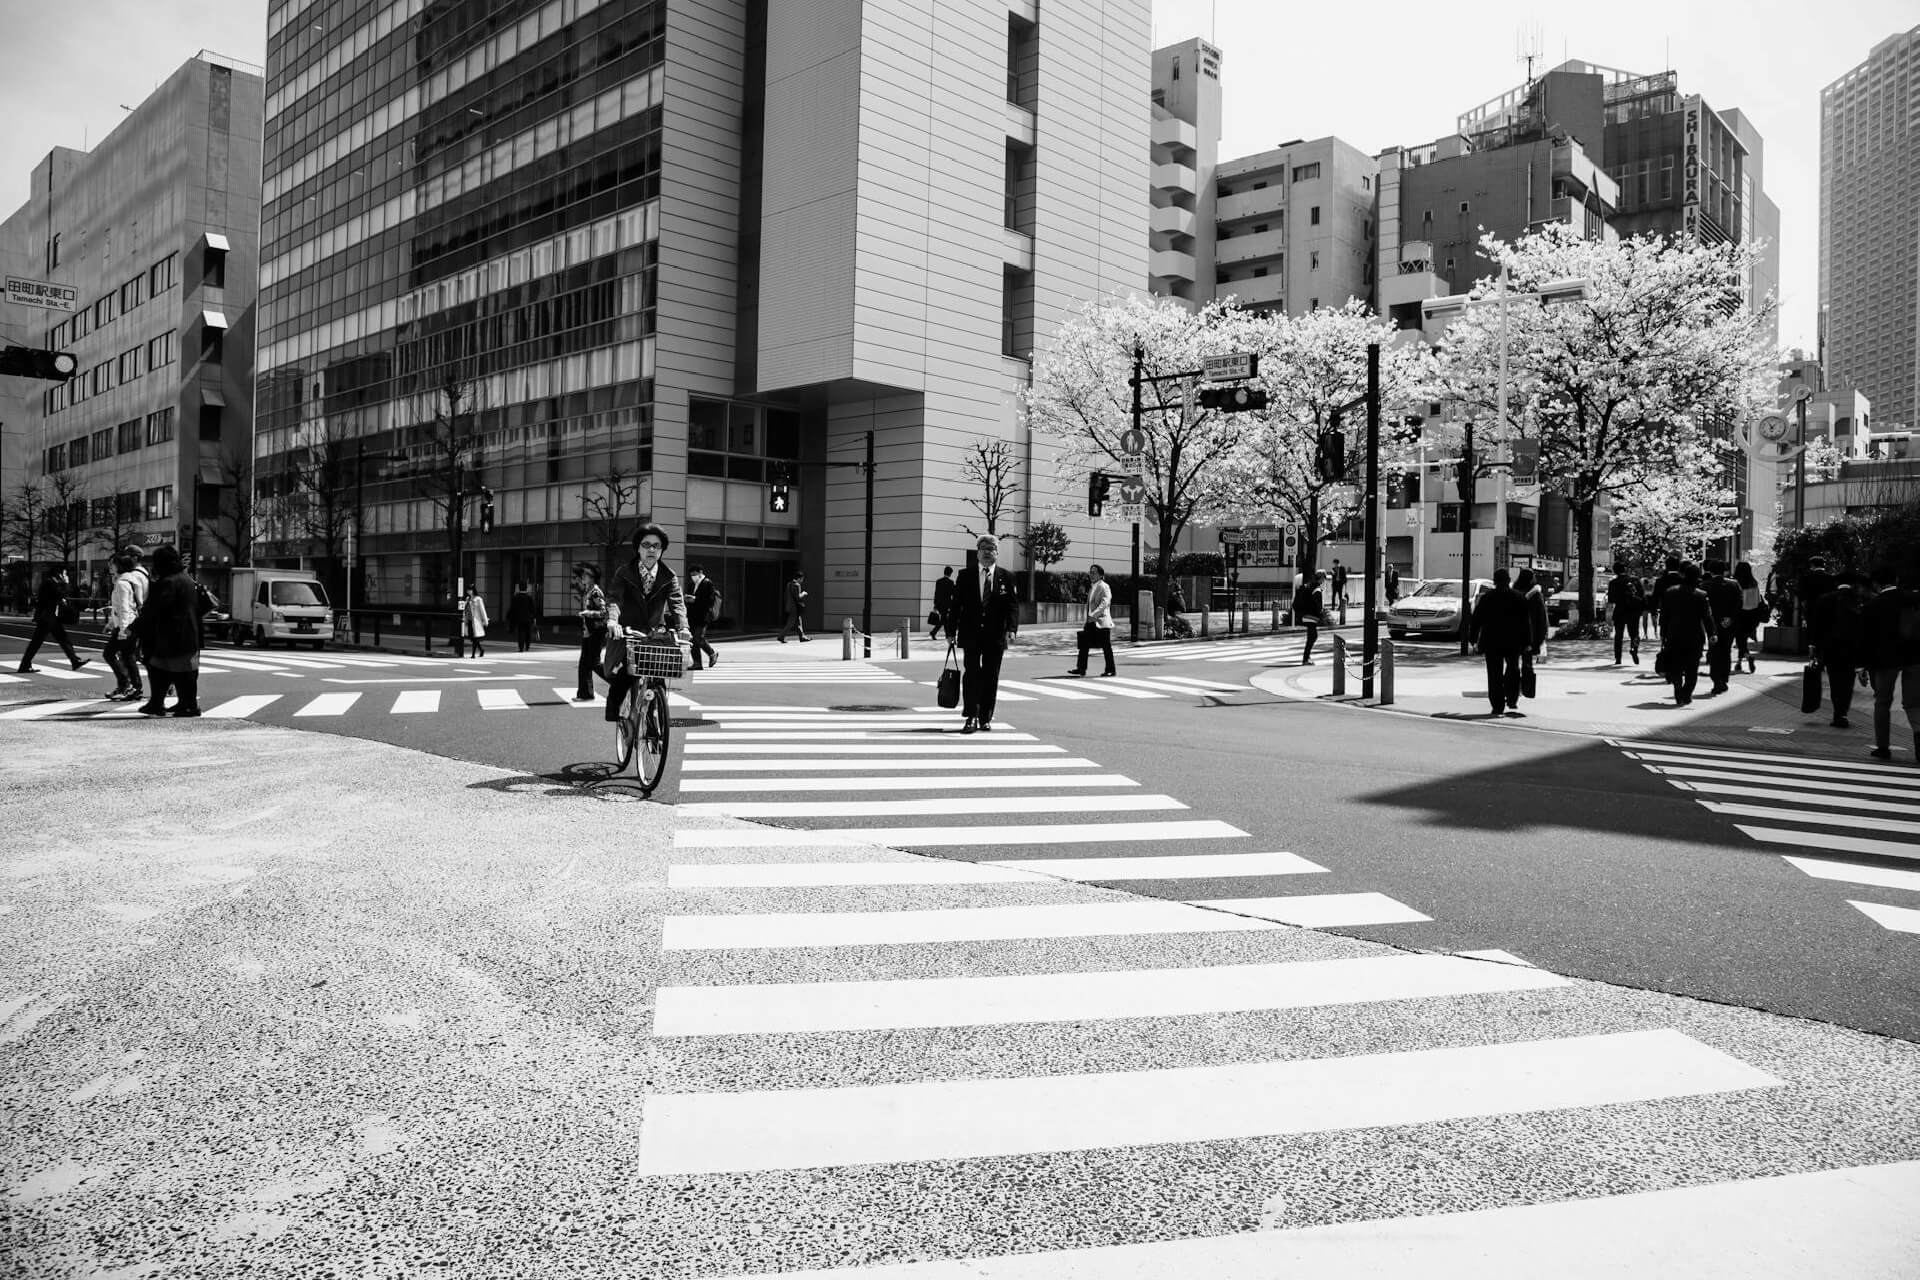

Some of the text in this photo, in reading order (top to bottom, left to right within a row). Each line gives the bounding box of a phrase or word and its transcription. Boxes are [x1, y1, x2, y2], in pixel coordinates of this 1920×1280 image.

[1685, 110, 1698, 202] SHIBAURA
[8, 280, 75, 300] 田町駅東口
[12, 294, 43, 305] Tamachi
[1206, 356, 1248, 370] 田町駅東口
